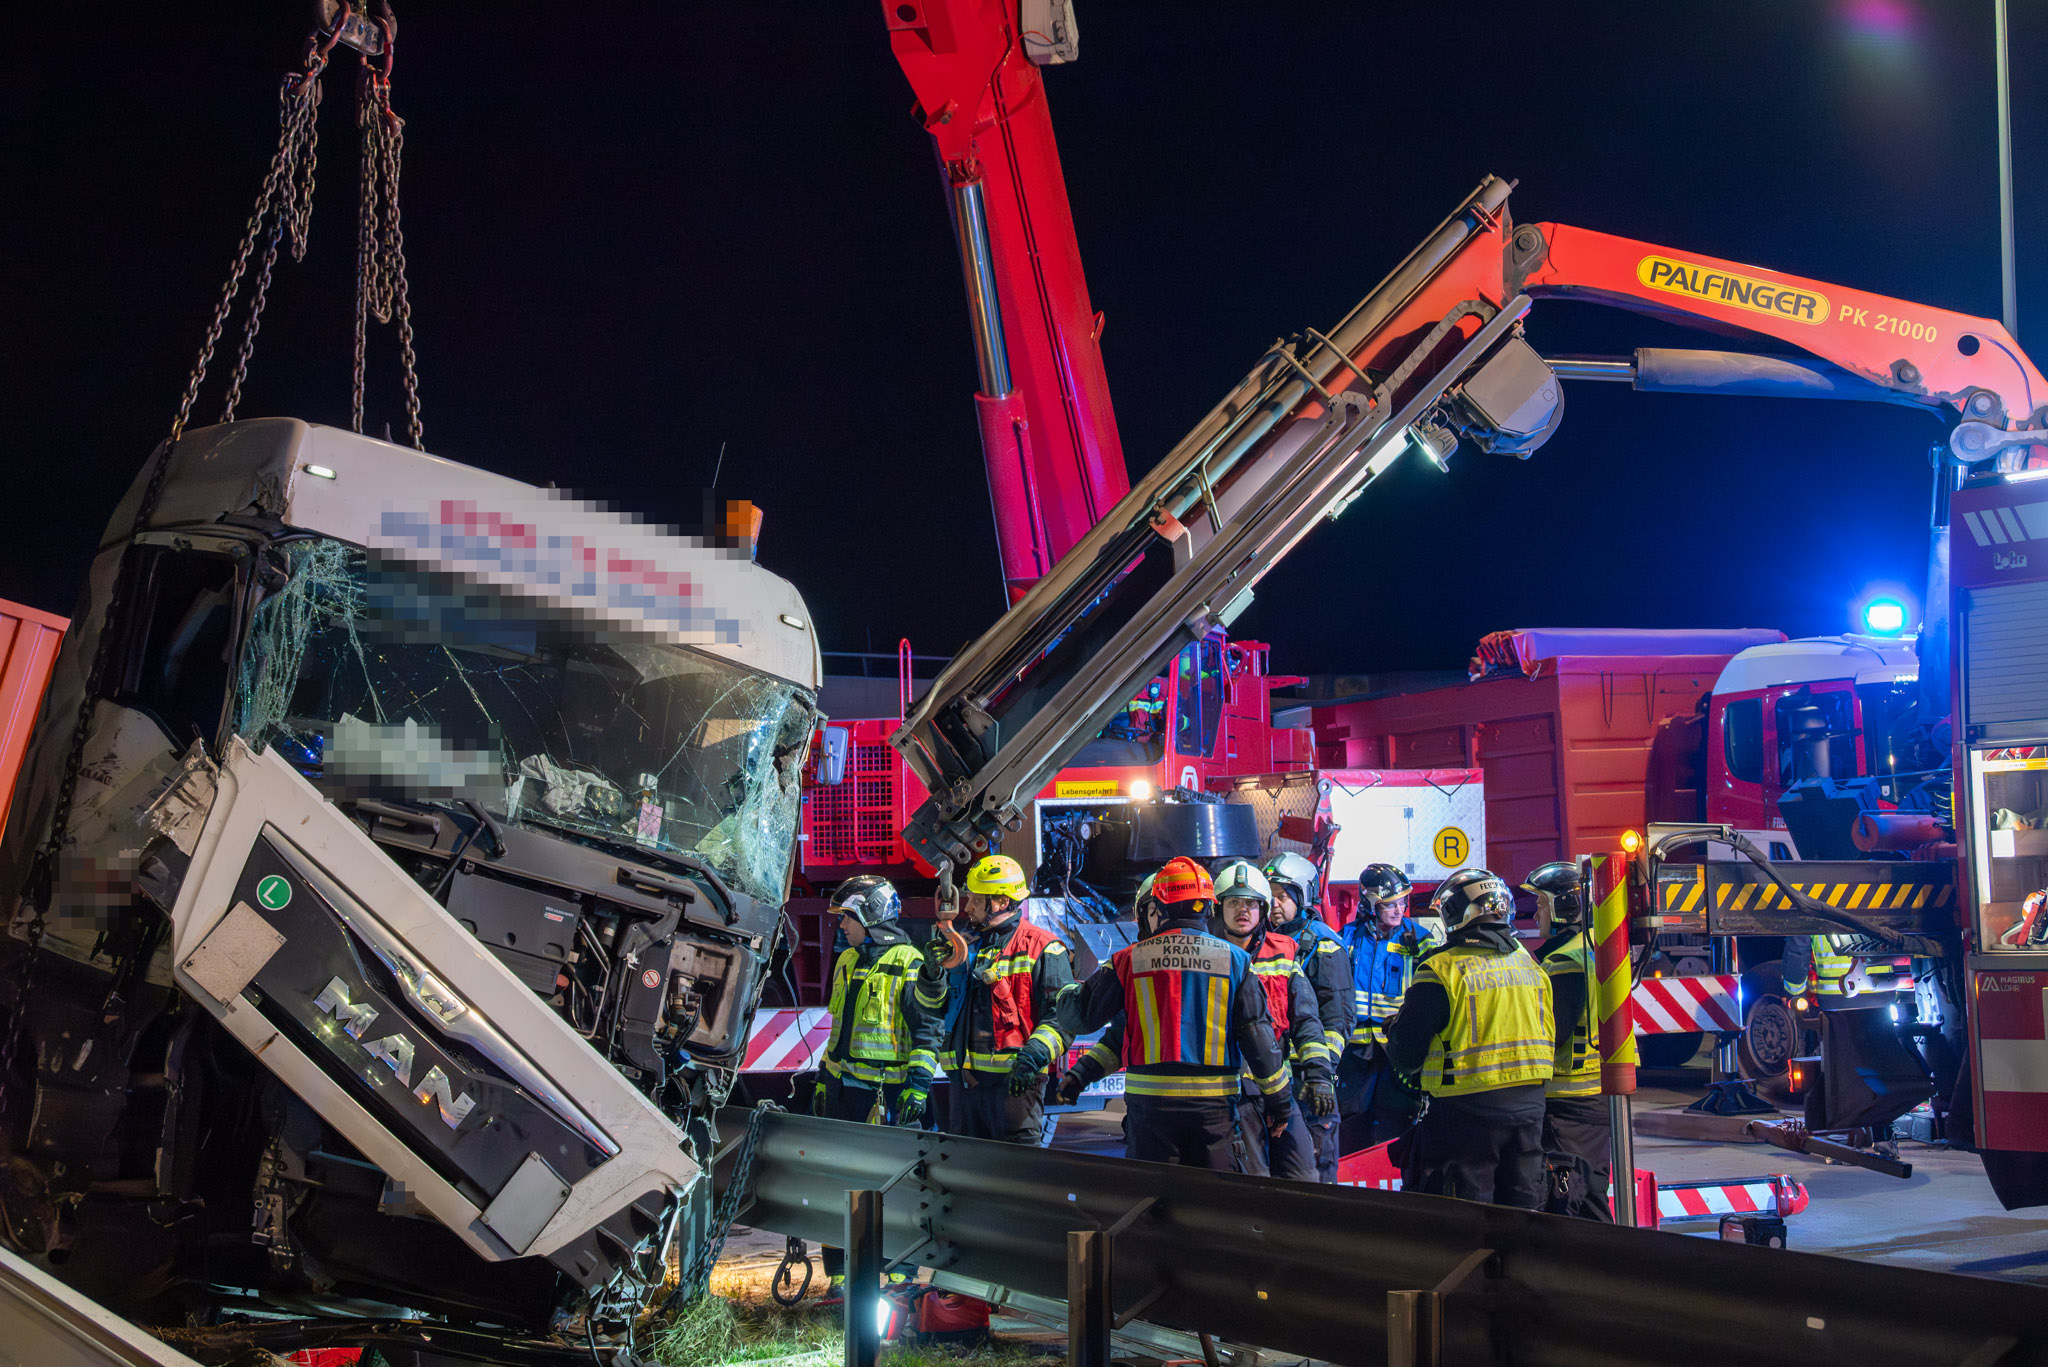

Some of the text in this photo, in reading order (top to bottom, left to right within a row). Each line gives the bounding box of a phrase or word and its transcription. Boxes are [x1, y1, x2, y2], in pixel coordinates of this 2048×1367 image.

[1649, 260, 1818, 320] PALFINGER
[1838, 304, 1938, 344] PK 21000
[1443, 836, 1460, 859] R
[262, 880, 279, 905] L
[1163, 945, 1200, 956] KRAN
[1151, 955, 1212, 971] MÖDLING
[2000, 976, 2036, 984] MAGIRUS
[313, 975, 477, 1130] MAN
